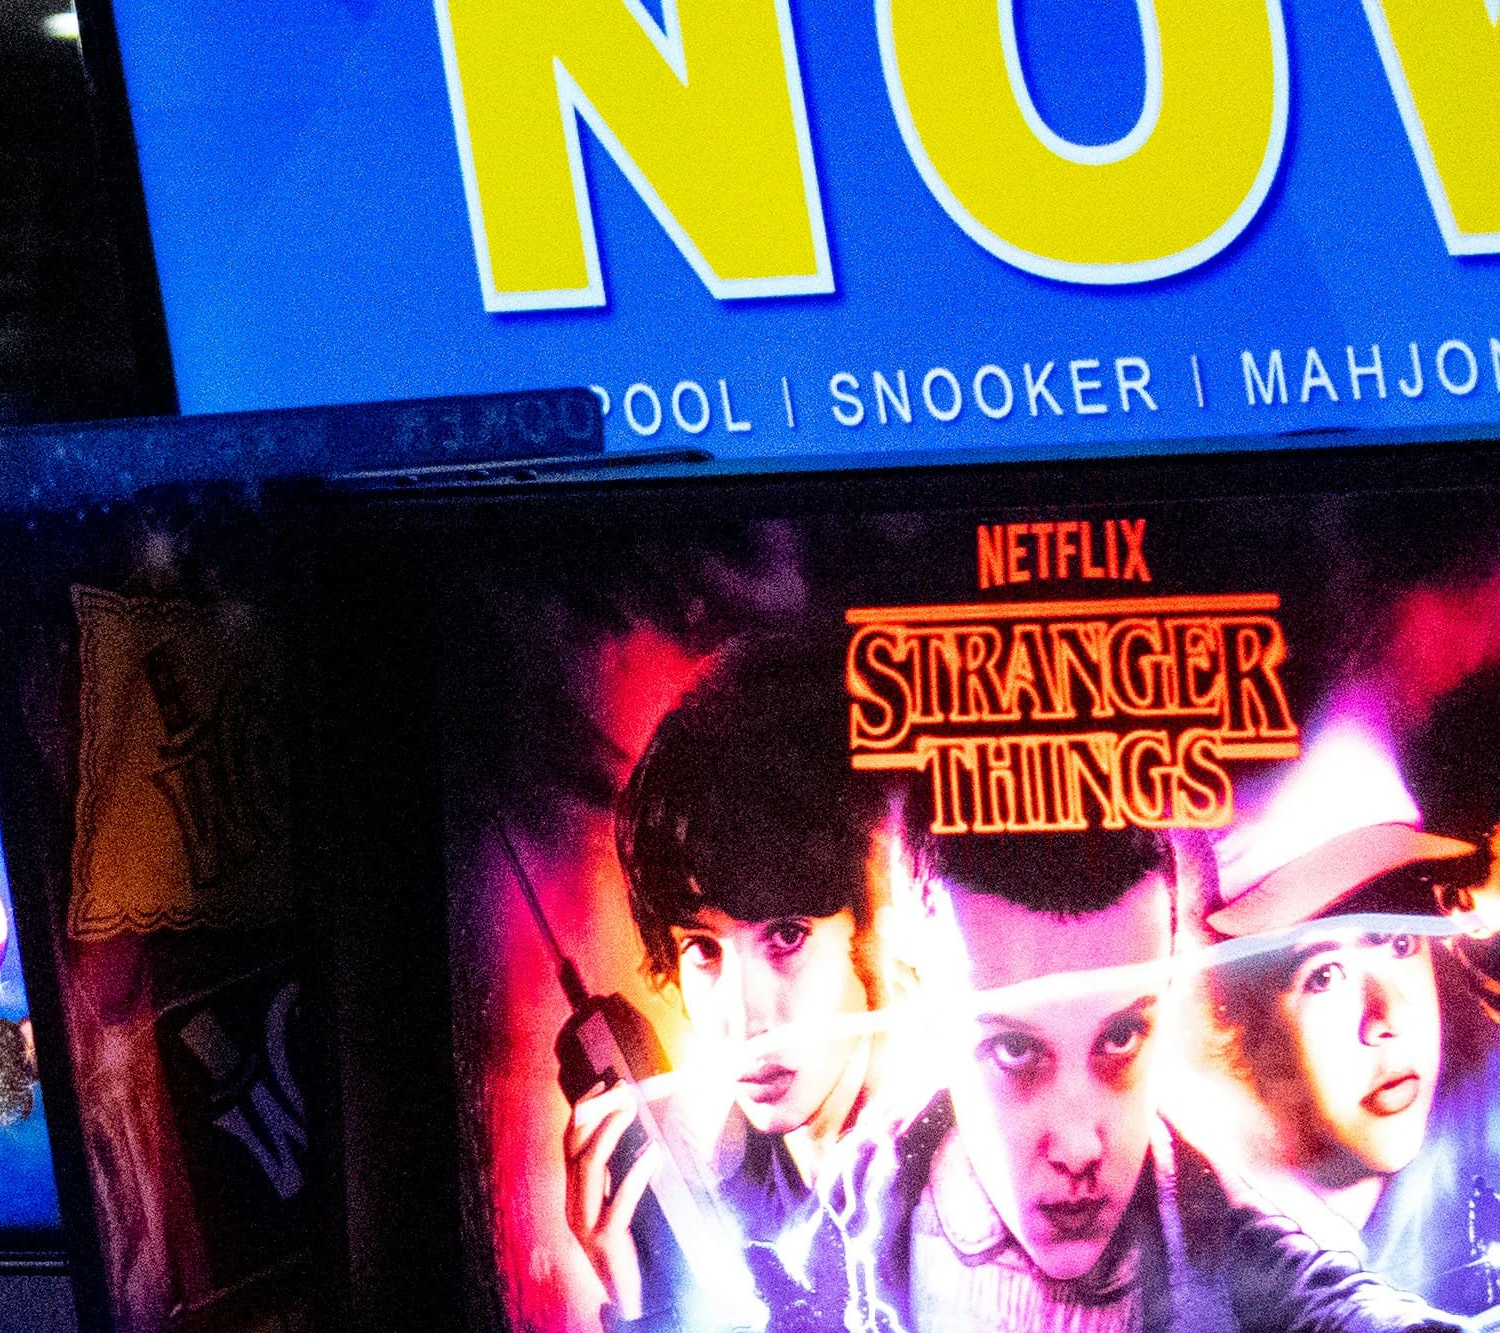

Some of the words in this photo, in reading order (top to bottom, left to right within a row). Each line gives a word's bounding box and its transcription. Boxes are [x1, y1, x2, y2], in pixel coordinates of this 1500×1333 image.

[432, 0, 1500, 314] NO
[831, 355, 1157, 428] SNOOKER
[975, 518, 1152, 588] NETFLIX
[846, 614, 1300, 752] STRANGER
[916, 728, 1235, 834] THINGS
